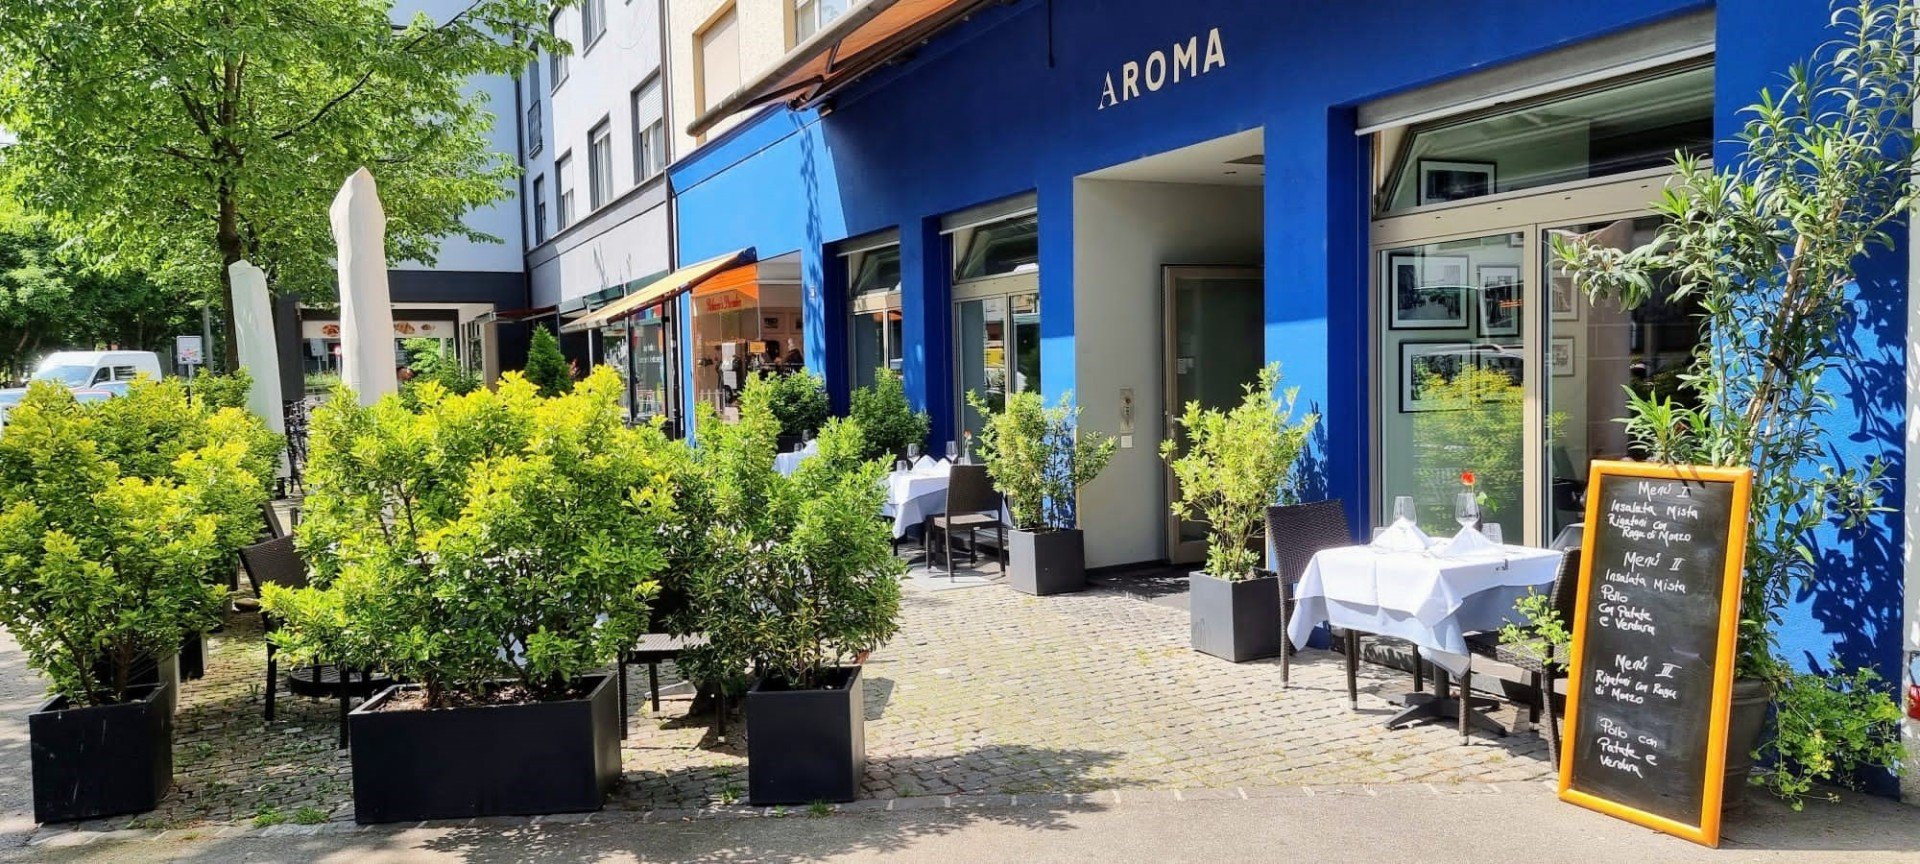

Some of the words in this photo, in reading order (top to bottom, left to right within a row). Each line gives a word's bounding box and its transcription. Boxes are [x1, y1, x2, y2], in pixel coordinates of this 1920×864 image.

[1098, 27, 1226, 110] AROMA
[1676, 486, 1693, 498] I
[1611, 499, 1657, 516] Insalata
[1666, 506, 1698, 520] Mista
[1607, 513, 1648, 529] Rigatoni
[1647, 529, 1657, 539] di
[1669, 557, 1687, 571] II
[1605, 568, 1647, 587] Insalata
[1653, 578, 1686, 594] Mista
[1601, 584, 1628, 603] Pollo
[1617, 605, 1652, 621] Patate
[1615, 618, 1655, 636] Verdura
[1595, 669, 1632, 687] Rigatoni
[1655, 663, 1683, 678] III
[1595, 685, 1604, 695] di
[1600, 718, 1627, 739] Pollo
[1597, 736, 1641, 759] Patate
[1600, 754, 1643, 779] Verdura
